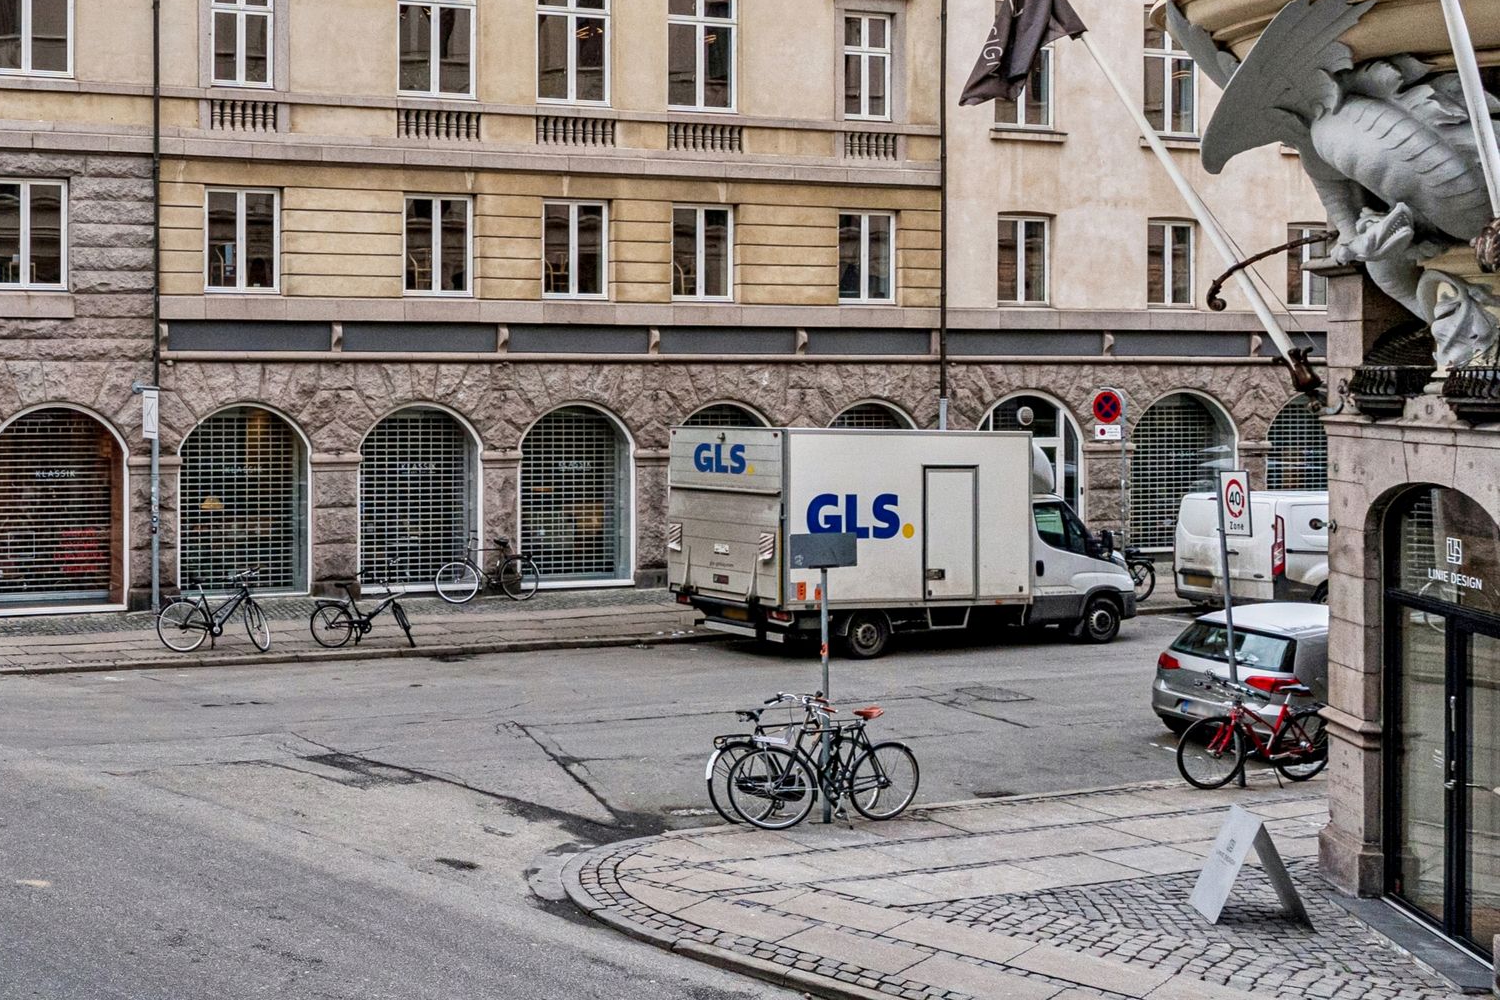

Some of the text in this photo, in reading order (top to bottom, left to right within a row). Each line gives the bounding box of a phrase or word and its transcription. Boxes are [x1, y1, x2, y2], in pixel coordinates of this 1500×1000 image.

[35, 470, 76, 478] KLASSIK
[1229, 491, 1241, 506] 40
[1229, 521, 1245, 530] Zone
[1428, 568, 1483, 590] LINIE DESIGN
